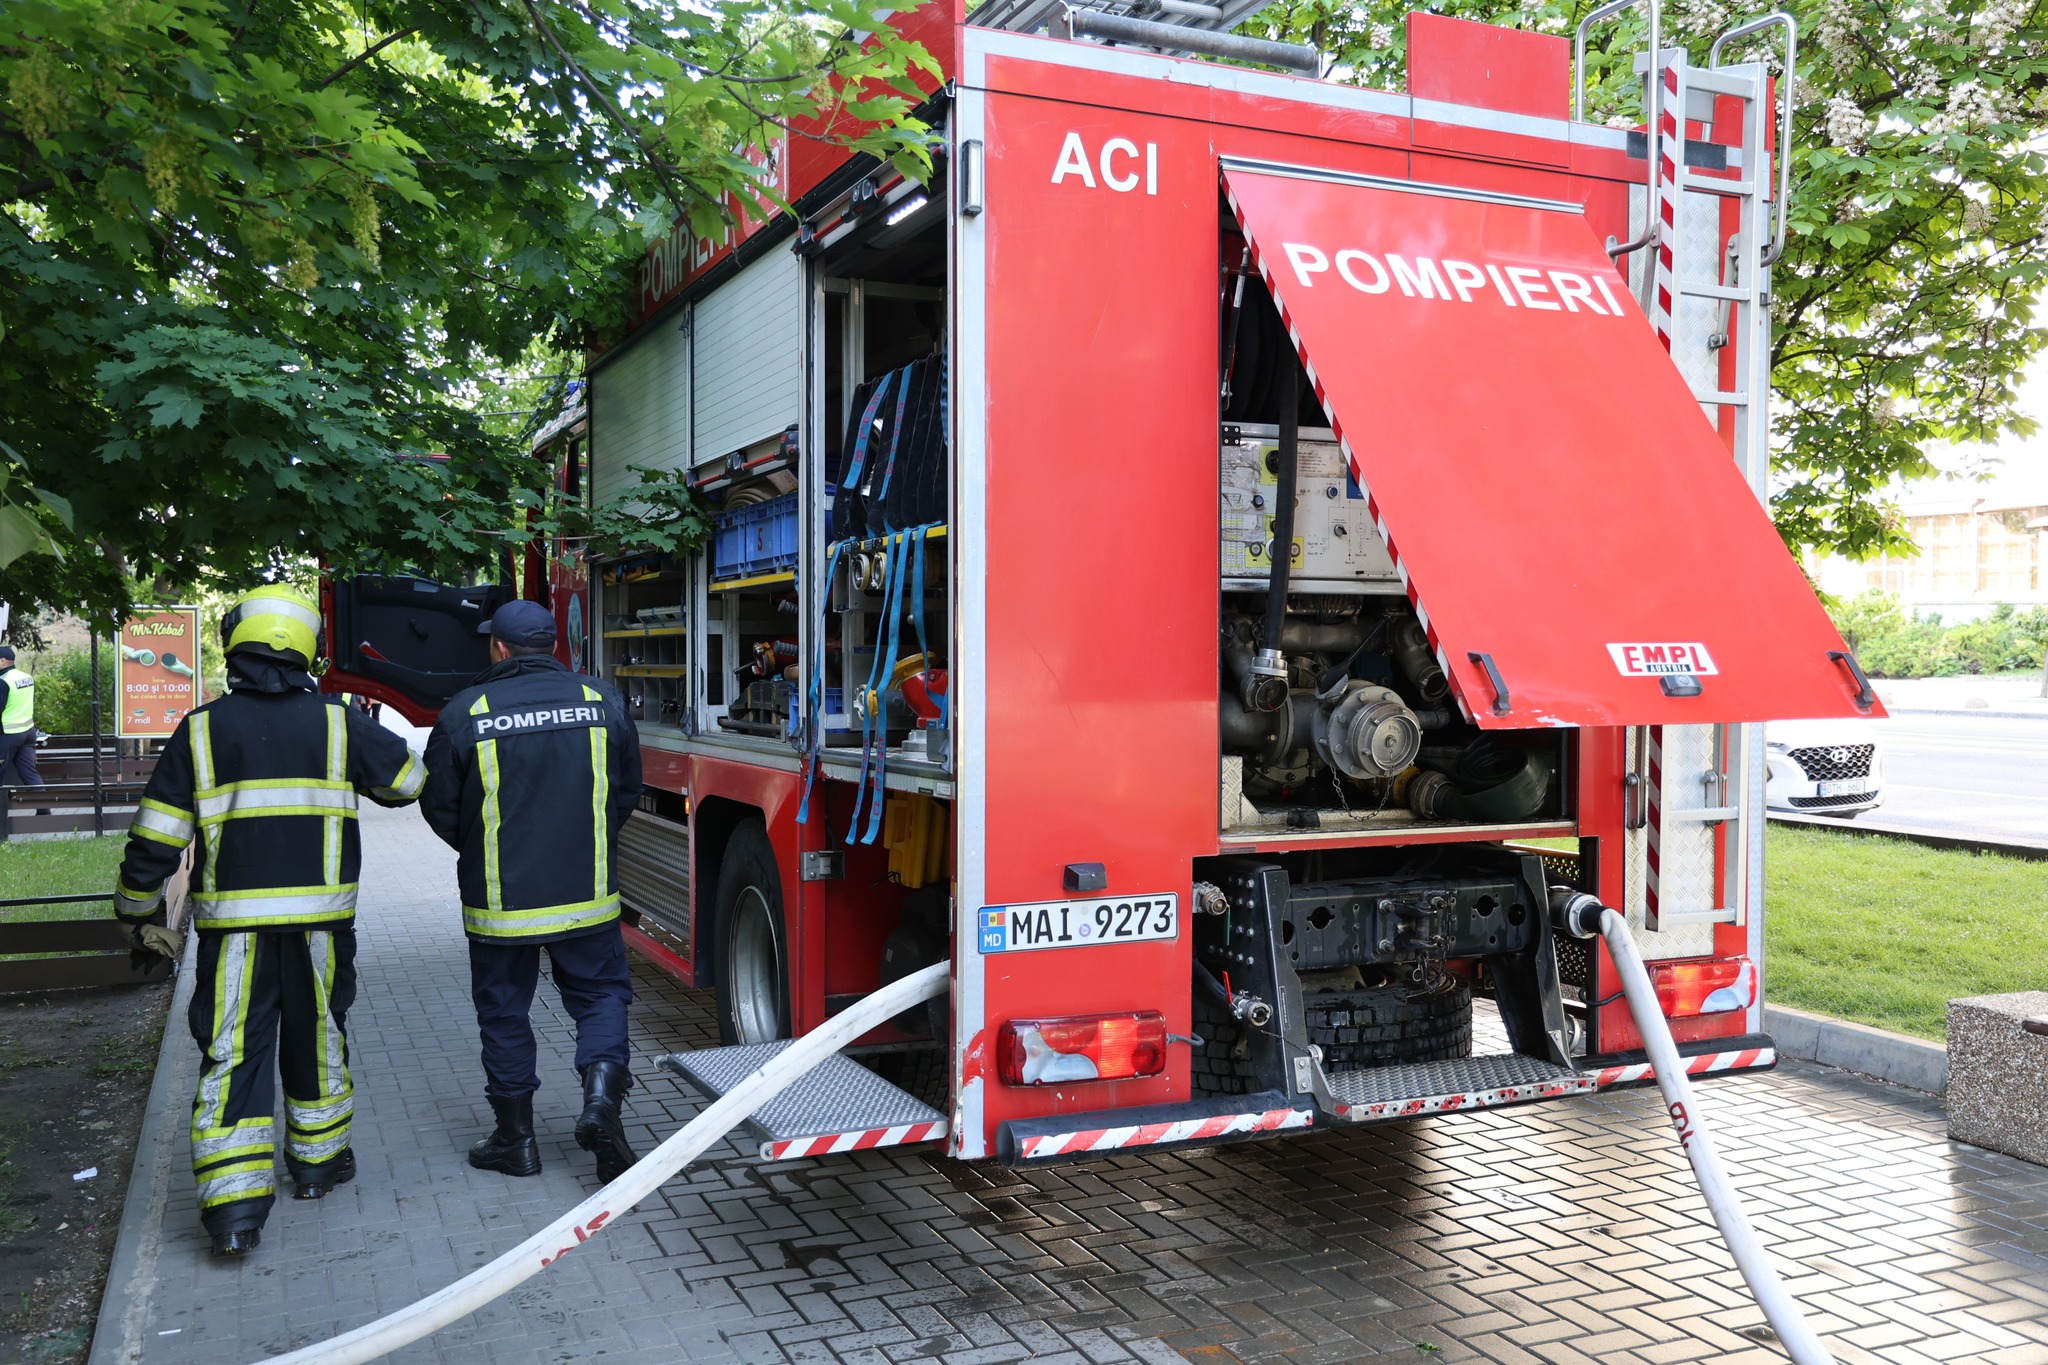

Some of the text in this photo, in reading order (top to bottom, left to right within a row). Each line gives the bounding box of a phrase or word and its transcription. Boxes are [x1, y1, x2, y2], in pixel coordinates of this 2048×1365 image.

[1050, 131, 1158, 196] ACI
[1282, 242, 1625, 317] POMPIERI
[1621, 646, 1708, 673] EMPL
[1649, 664, 1689, 672] AUSTRIA
[126, 684, 149, 692] 8:00
[163, 684, 191, 692] 10:00
[127, 716, 151, 724] 7 mdl
[163, 716, 172, 724] 15
[477, 707, 599, 735] POMPIERI
[984, 900, 1172, 947] MD MAI 9273
